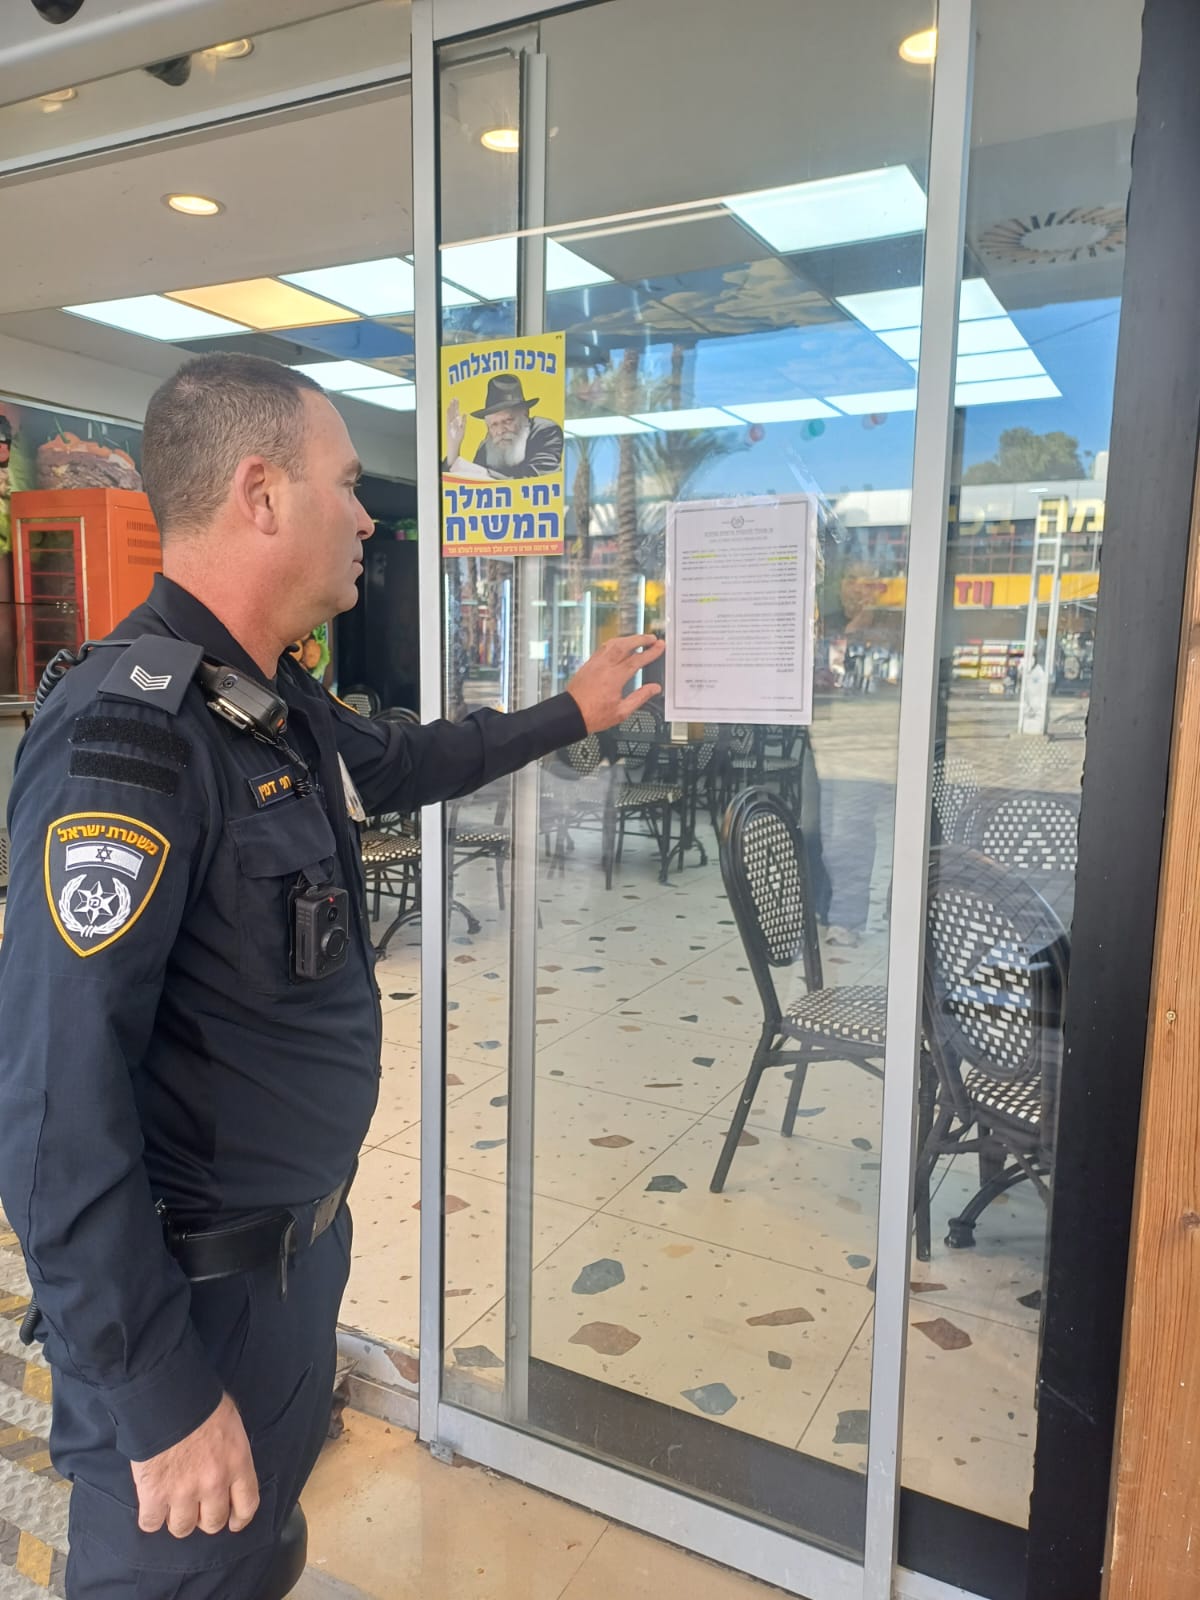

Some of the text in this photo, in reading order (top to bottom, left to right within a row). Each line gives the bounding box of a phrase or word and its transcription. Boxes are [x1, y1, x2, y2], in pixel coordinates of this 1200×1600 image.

[448, 349, 556, 385] ברכה והצלחה
[445, 483, 561, 514] יחי המלך
[446, 512, 559, 542] המשיח
[57, 824, 159, 856] משטרת ישראל
